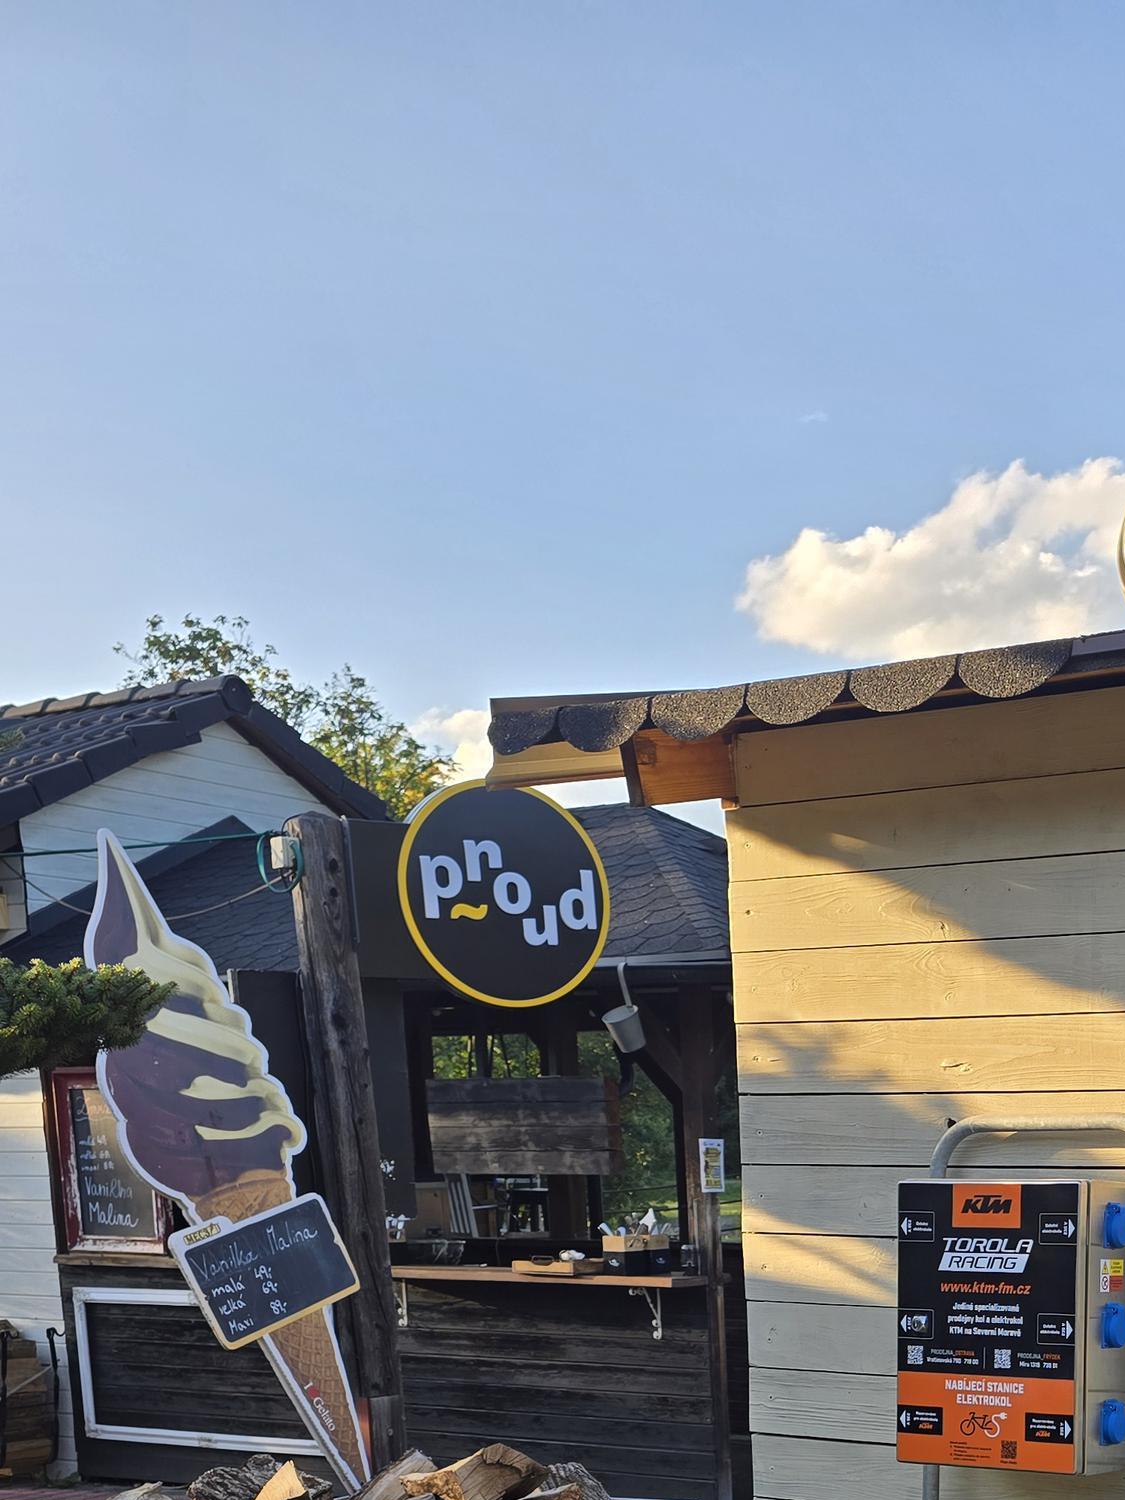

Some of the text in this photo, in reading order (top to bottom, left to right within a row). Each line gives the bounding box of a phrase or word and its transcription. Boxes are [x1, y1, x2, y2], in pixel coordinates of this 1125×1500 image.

[961, 1195, 1013, 1214] KTM
[88, 1201, 140, 1228] Malina
[190, 1221, 318, 1281] Vanilka Malina
[942, 1237, 1034, 1253] TOROLA
[948, 1255, 1018, 1270] RACING
[211, 1274, 247, 1298] malá
[940, 1281, 1032, 1295] www.ktm-fm.cz
[949, 1326, 964, 1335] KTM
[945, 1377, 1025, 1395] NABÍJECÍ STANICE
[956, 1393, 1013, 1408] ELEKTROKOL
[313, 1396, 337, 1432] Gelato
